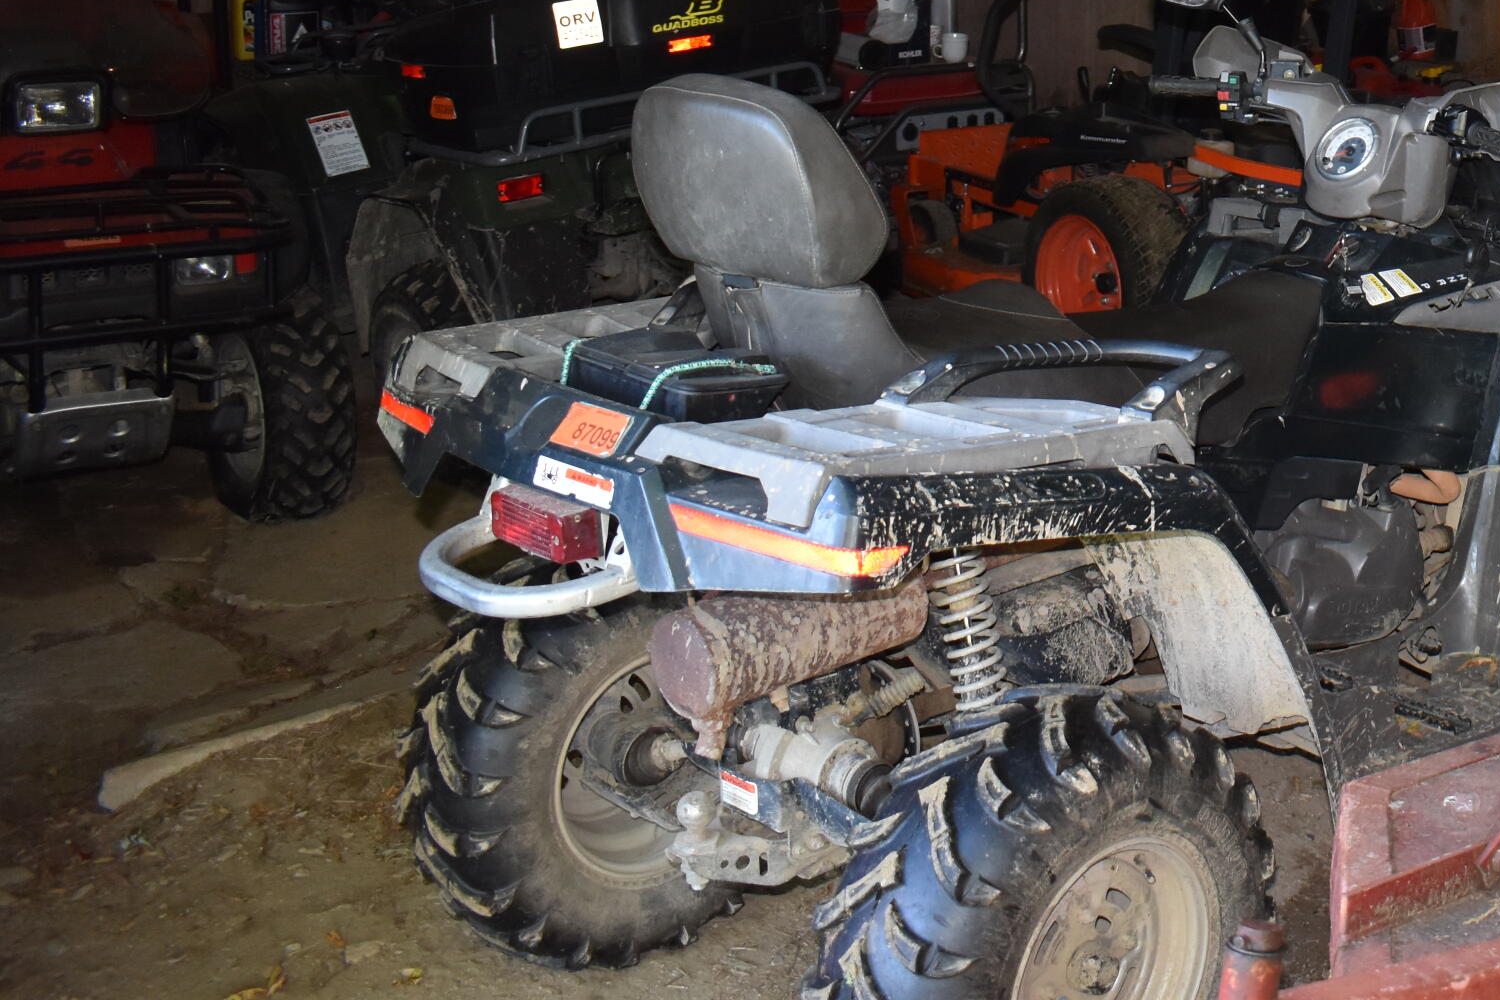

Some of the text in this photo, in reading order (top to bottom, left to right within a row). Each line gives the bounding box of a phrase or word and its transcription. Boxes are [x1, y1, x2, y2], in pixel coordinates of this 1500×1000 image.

[559, 10, 595, 27] ORV
[652, 14, 724, 33] QUADBOSS
[570, 422, 621, 450] 87099
